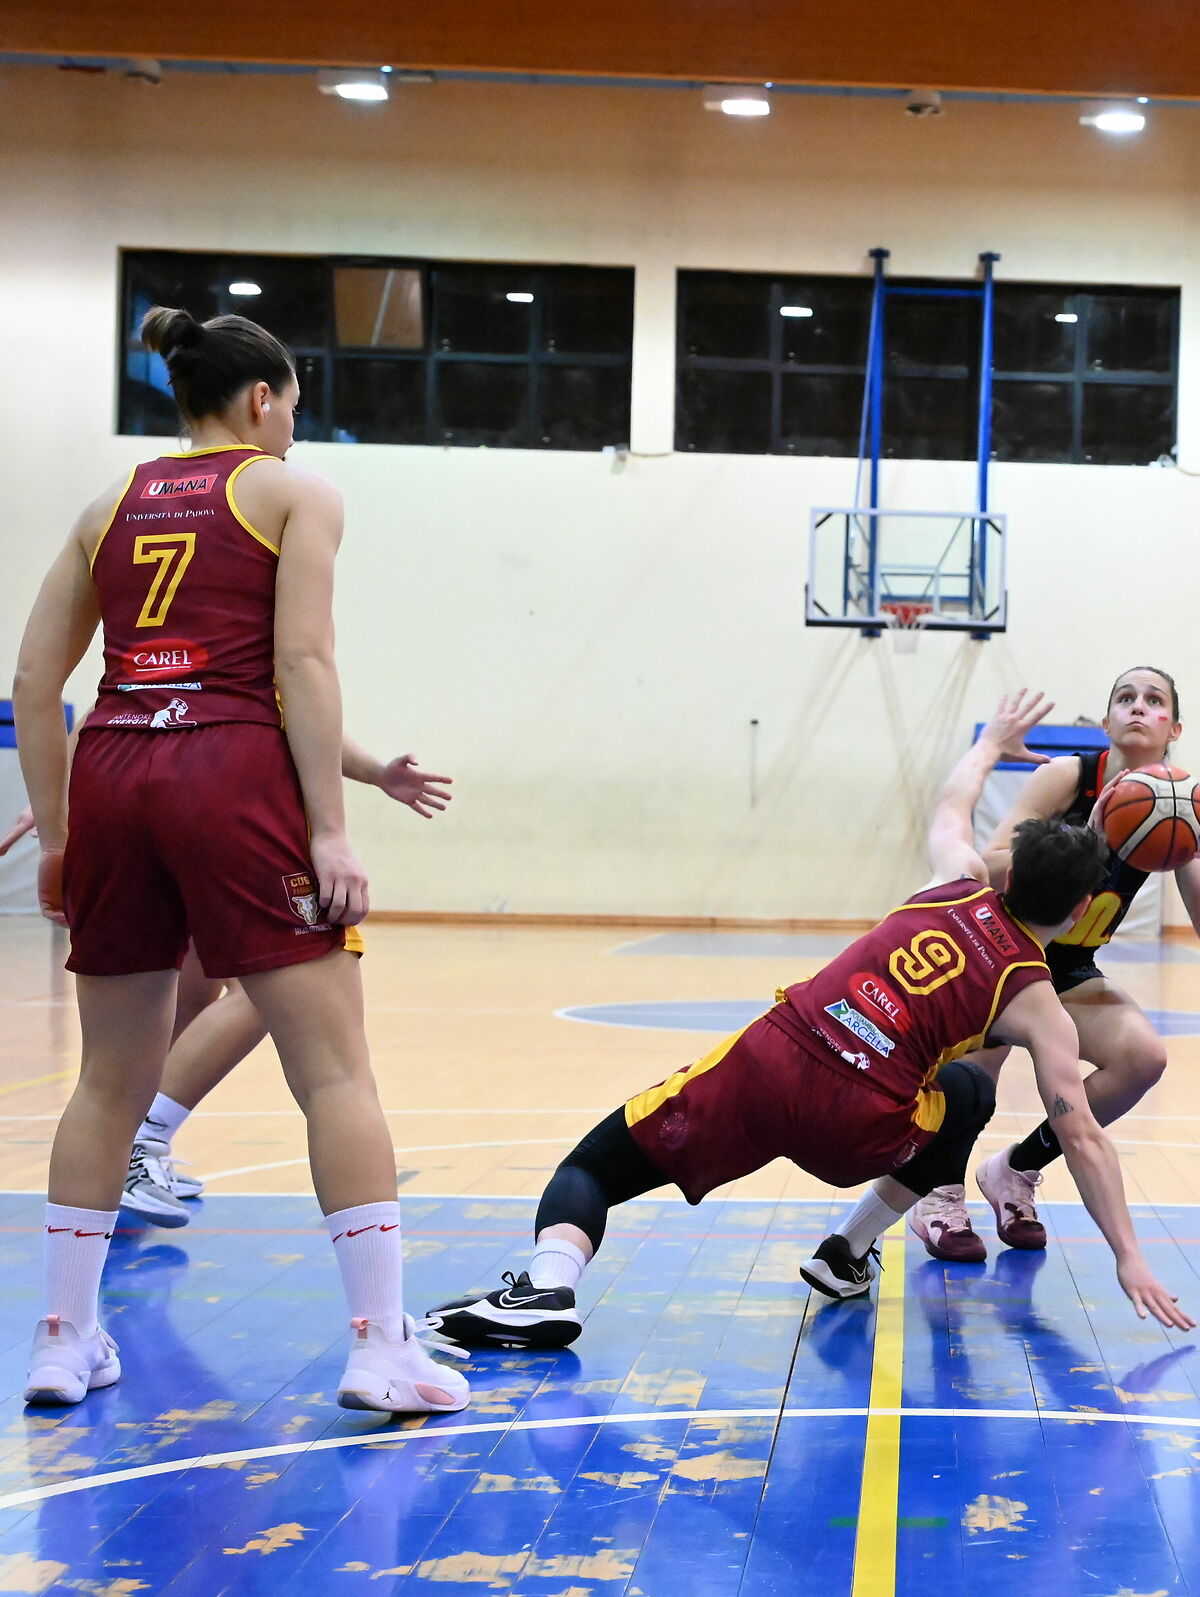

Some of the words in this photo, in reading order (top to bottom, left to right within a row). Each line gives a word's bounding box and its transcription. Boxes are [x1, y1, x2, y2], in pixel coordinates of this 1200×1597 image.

[148, 478, 207, 496] UMANA
[133, 532, 196, 628] 7
[133, 649, 193, 667] CAREL
[975, 906, 1012, 952] UMANA
[889, 930, 965, 995] 9
[842, 1017, 889, 1057] ARCELLA
